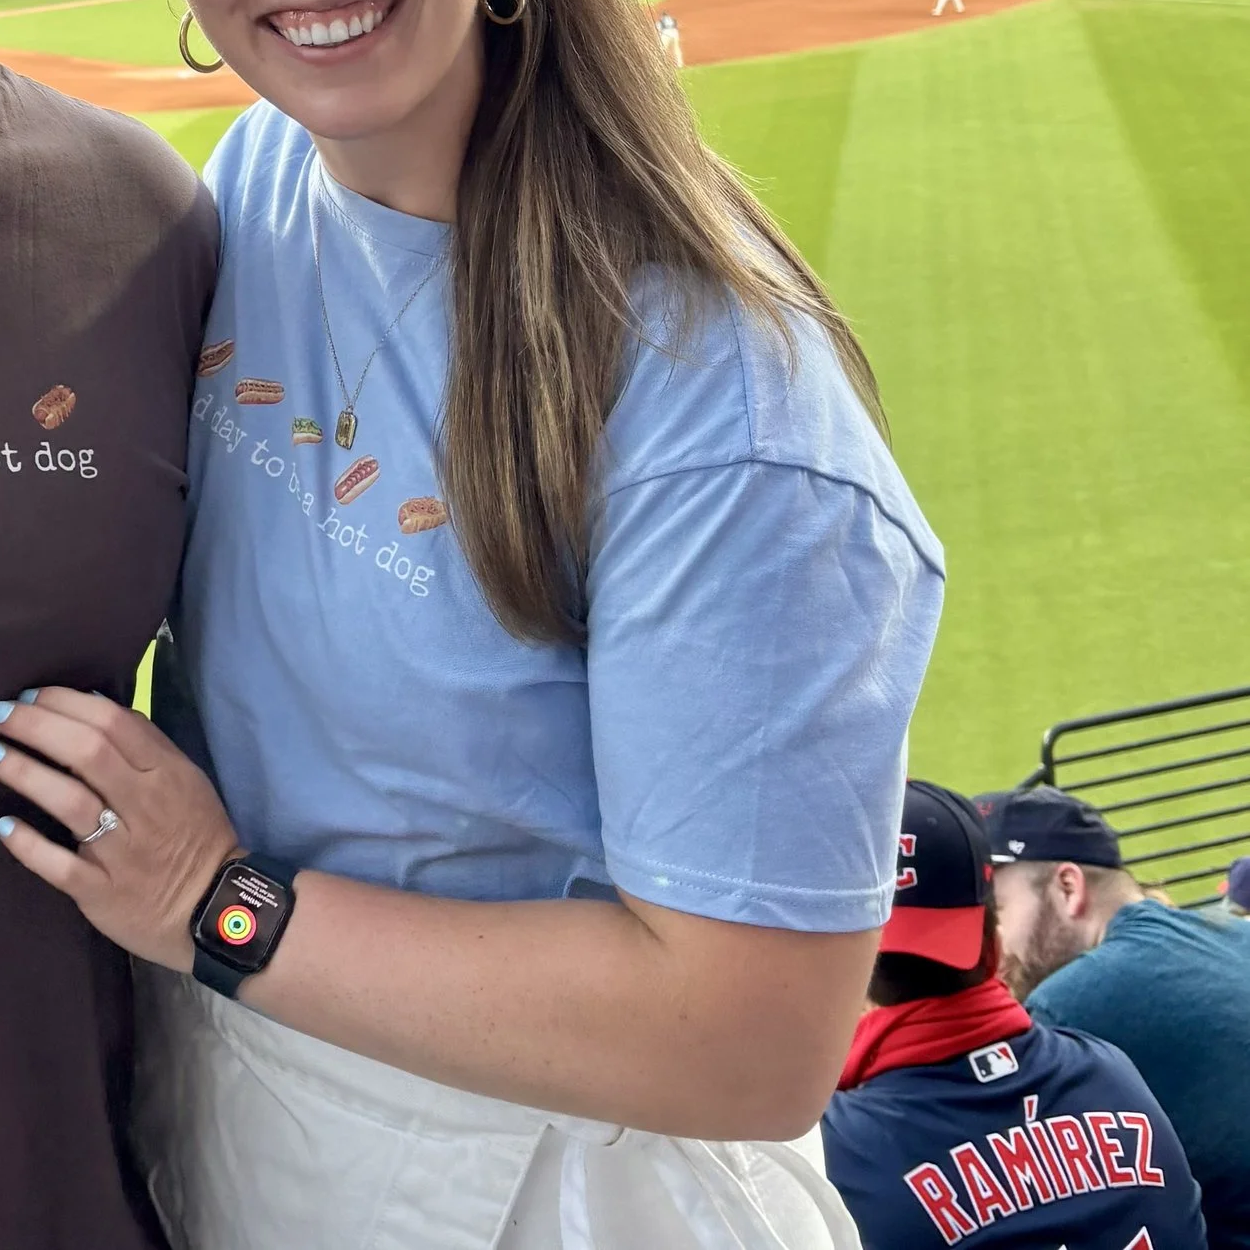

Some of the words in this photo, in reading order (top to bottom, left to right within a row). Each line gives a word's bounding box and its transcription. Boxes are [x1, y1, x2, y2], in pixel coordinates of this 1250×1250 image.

[34, 442, 98, 479] dog
[212, 406, 247, 453] day
[251, 439, 285, 477] to
[302, 492, 314, 516] a
[317, 507, 369, 555] hot
[375, 541, 435, 597] dog
[904, 1095, 1165, 1246] RAMÍREZ
